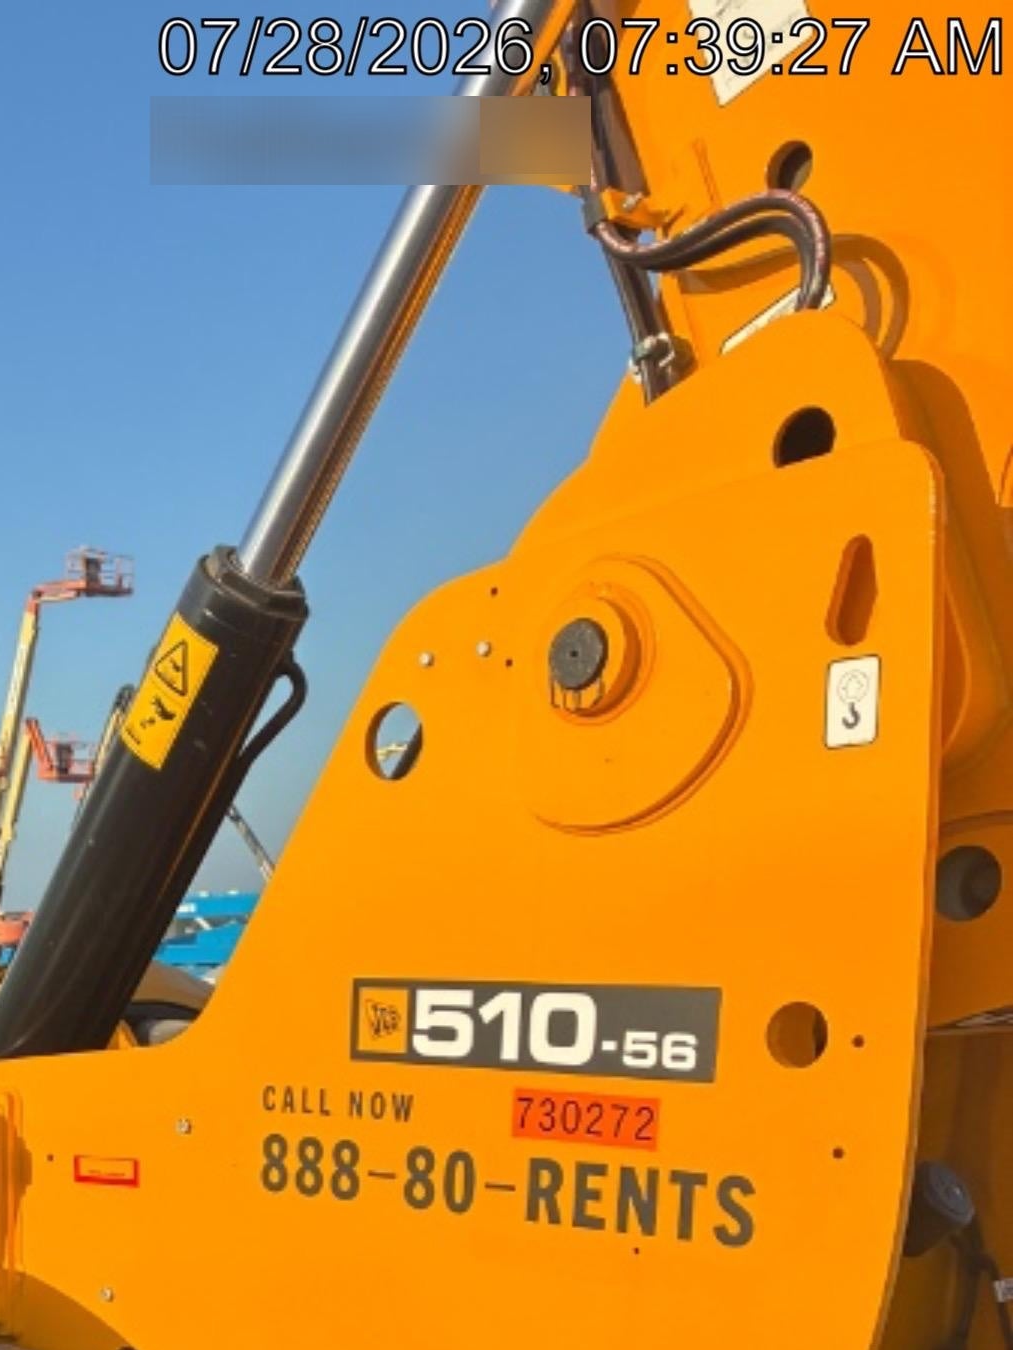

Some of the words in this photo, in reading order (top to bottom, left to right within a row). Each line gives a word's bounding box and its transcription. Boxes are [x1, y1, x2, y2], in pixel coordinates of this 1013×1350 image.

[412, 988, 698, 1071] 510-56
[262, 1085, 331, 1116] CALL
[348, 1091, 415, 1121] NOW
[517, 1097, 656, 1141] 730272
[261, 1133, 757, 1248] 888-80-RENTS
